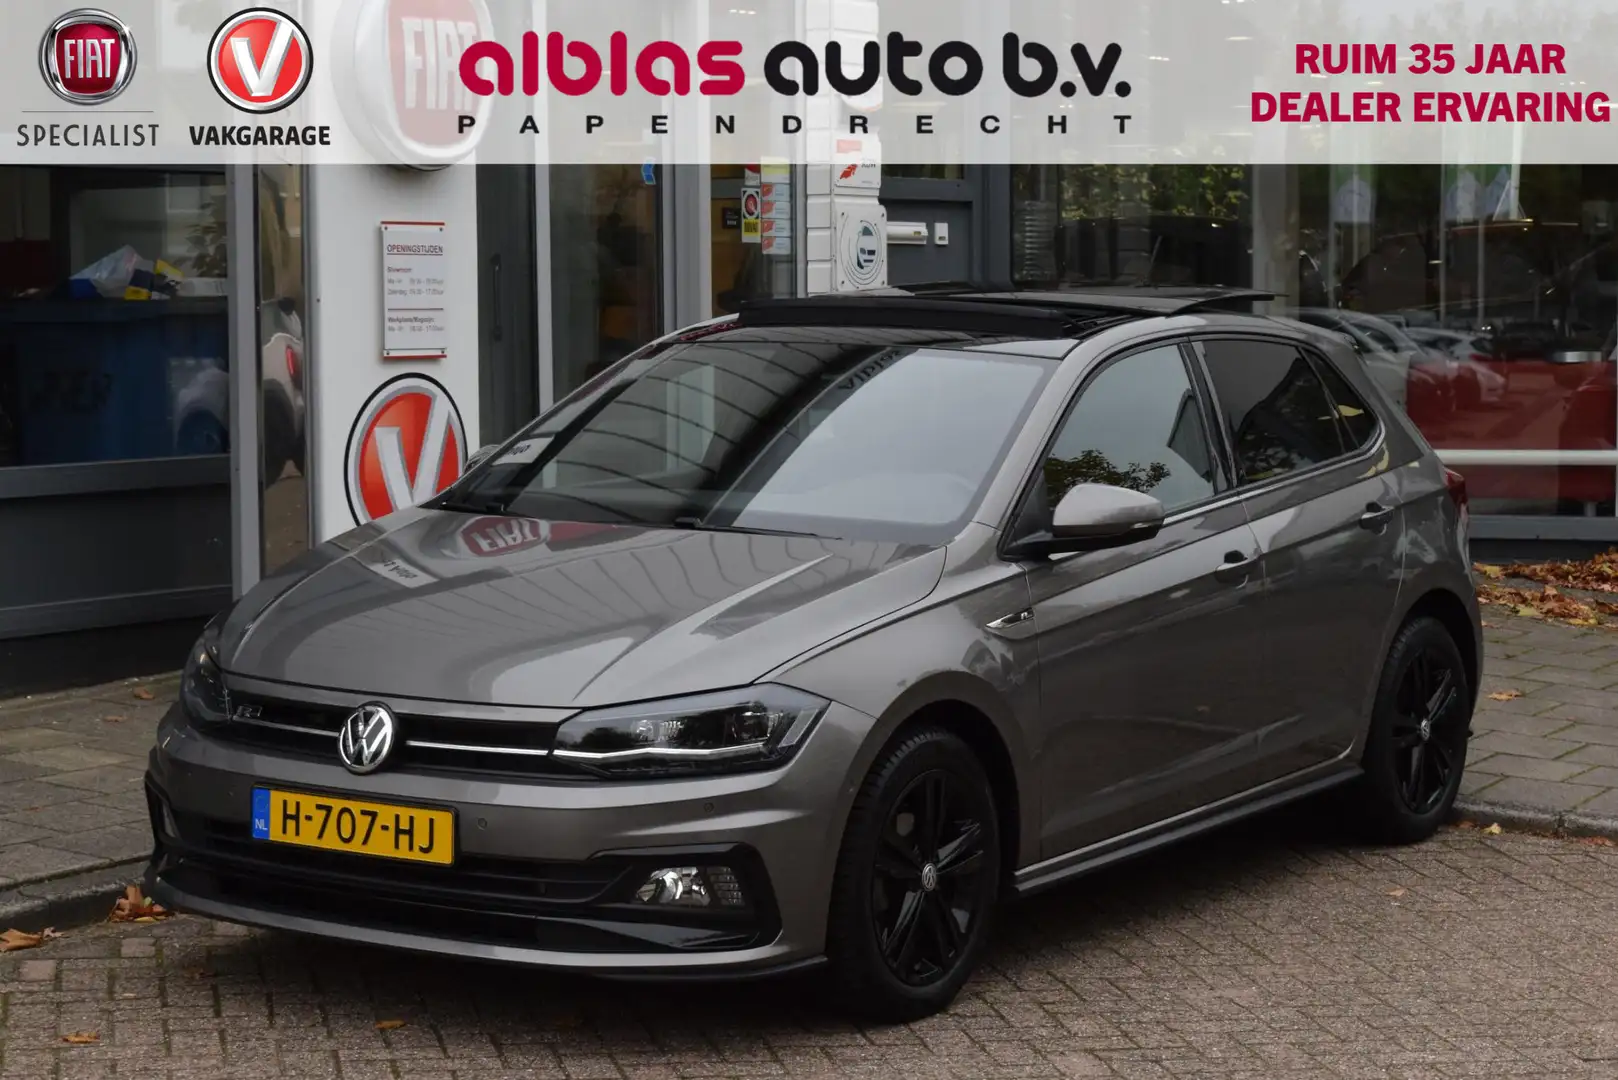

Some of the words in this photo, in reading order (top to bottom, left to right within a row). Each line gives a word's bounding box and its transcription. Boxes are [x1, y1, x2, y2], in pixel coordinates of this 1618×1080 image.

[401, 17, 478, 111] FIAT
[254, 818, 269, 831] NL
[281, 799, 436, 855] H-707-HJ
